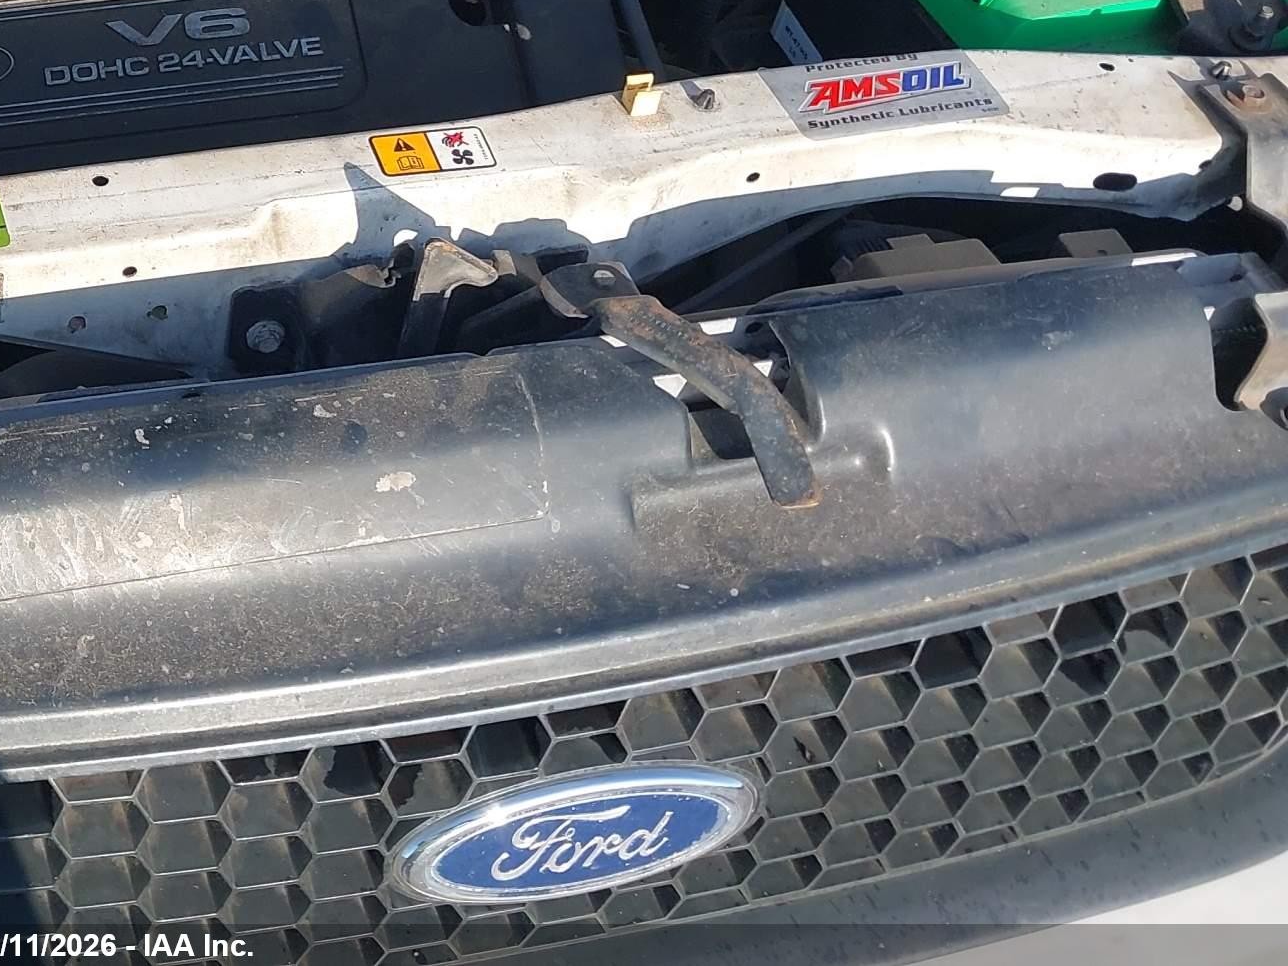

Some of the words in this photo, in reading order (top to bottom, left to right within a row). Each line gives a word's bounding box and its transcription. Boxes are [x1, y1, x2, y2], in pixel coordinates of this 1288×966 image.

[105, 6, 252, 47] V6
[43, 55, 151, 87] DOHC
[158, 36, 325, 75] 24-VALVE
[805, 56, 891, 73] Protected
[807, 63, 965, 109] AMSOIL
[807, 109, 894, 129] Synthetic
[898, 97, 993, 117] Lubricants
[490, 804, 675, 881] Ford
